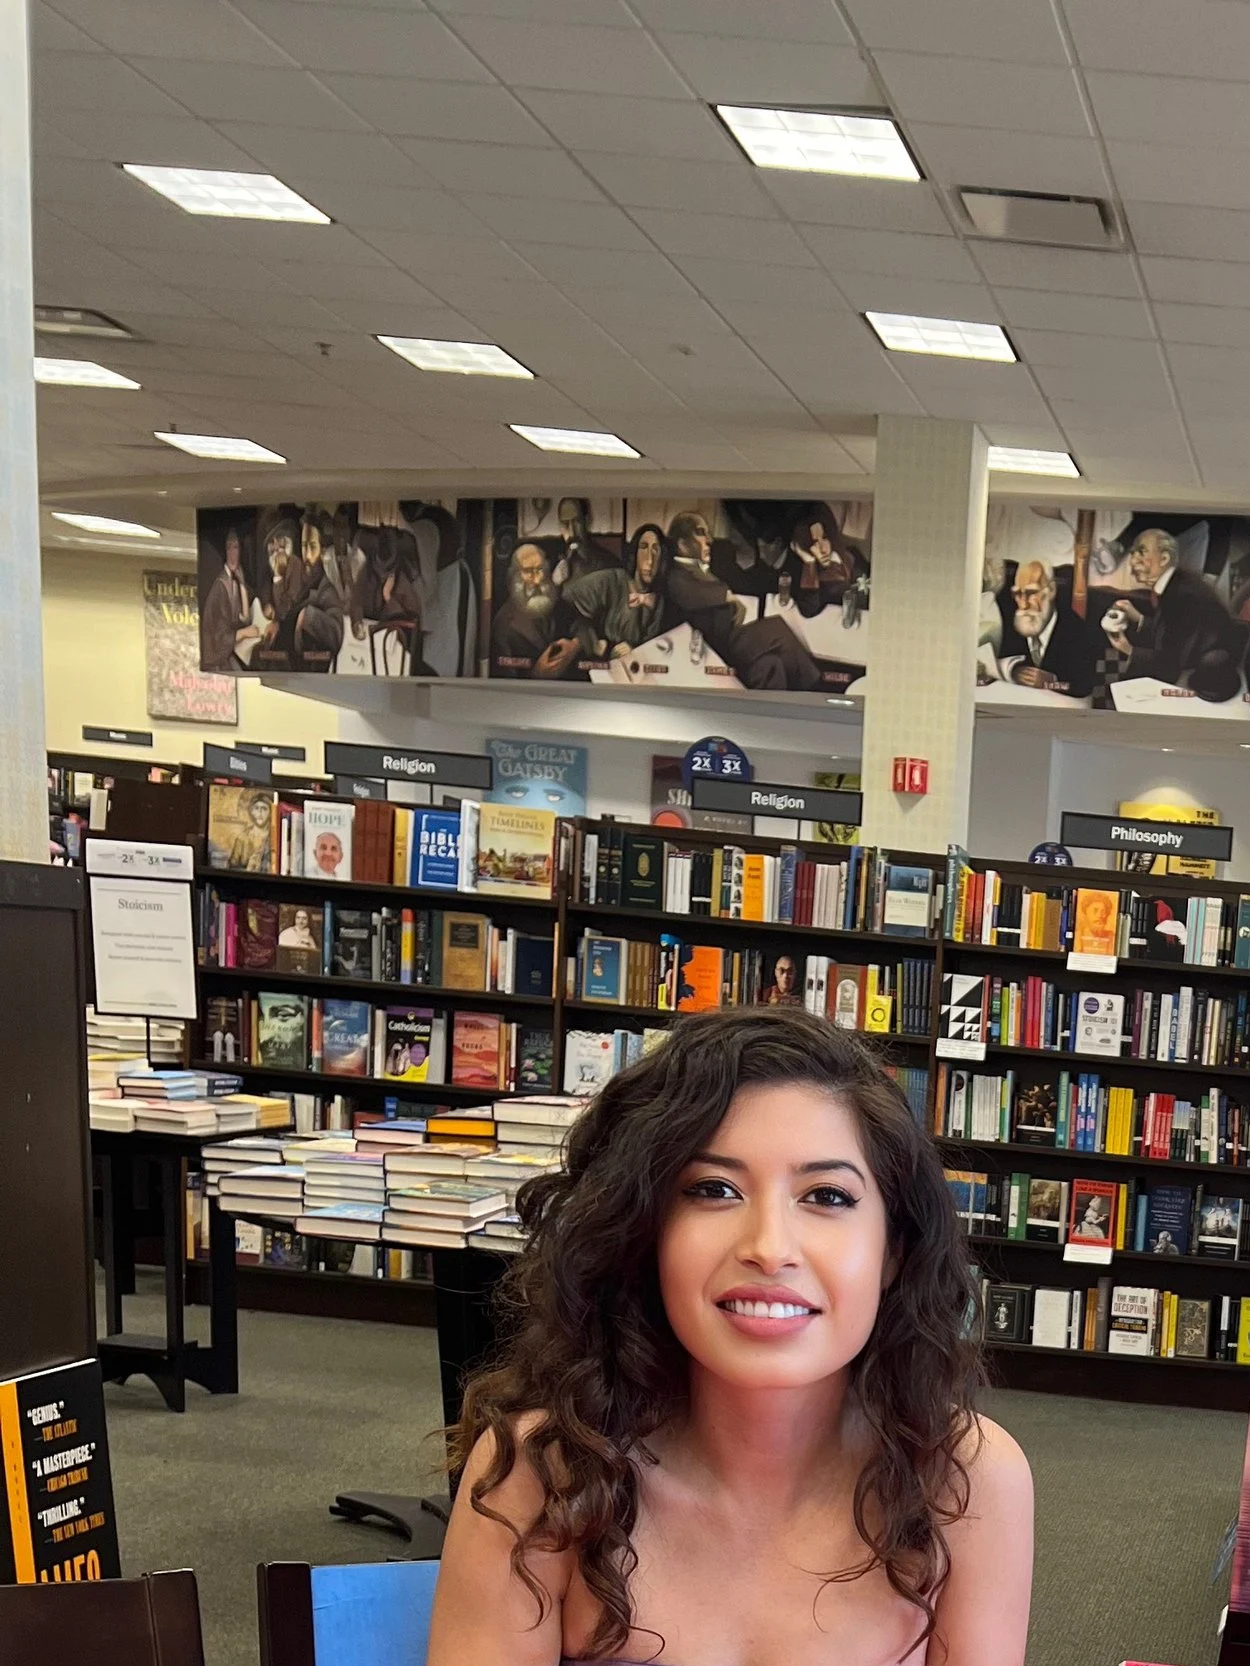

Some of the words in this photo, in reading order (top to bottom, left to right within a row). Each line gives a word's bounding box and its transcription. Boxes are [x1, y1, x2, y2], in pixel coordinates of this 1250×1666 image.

[524, 743, 576, 765] GREAT
[382, 755, 436, 776] Religion
[497, 760, 568, 782] GATSBY
[721, 759, 743, 775] 3X
[751, 791, 805, 811] Religion
[308, 812, 346, 827] HOPE
[490, 816, 546, 832] TIMELINES
[1111, 826, 1184, 848] Philosophy
[118, 898, 164, 912] Stoicism
